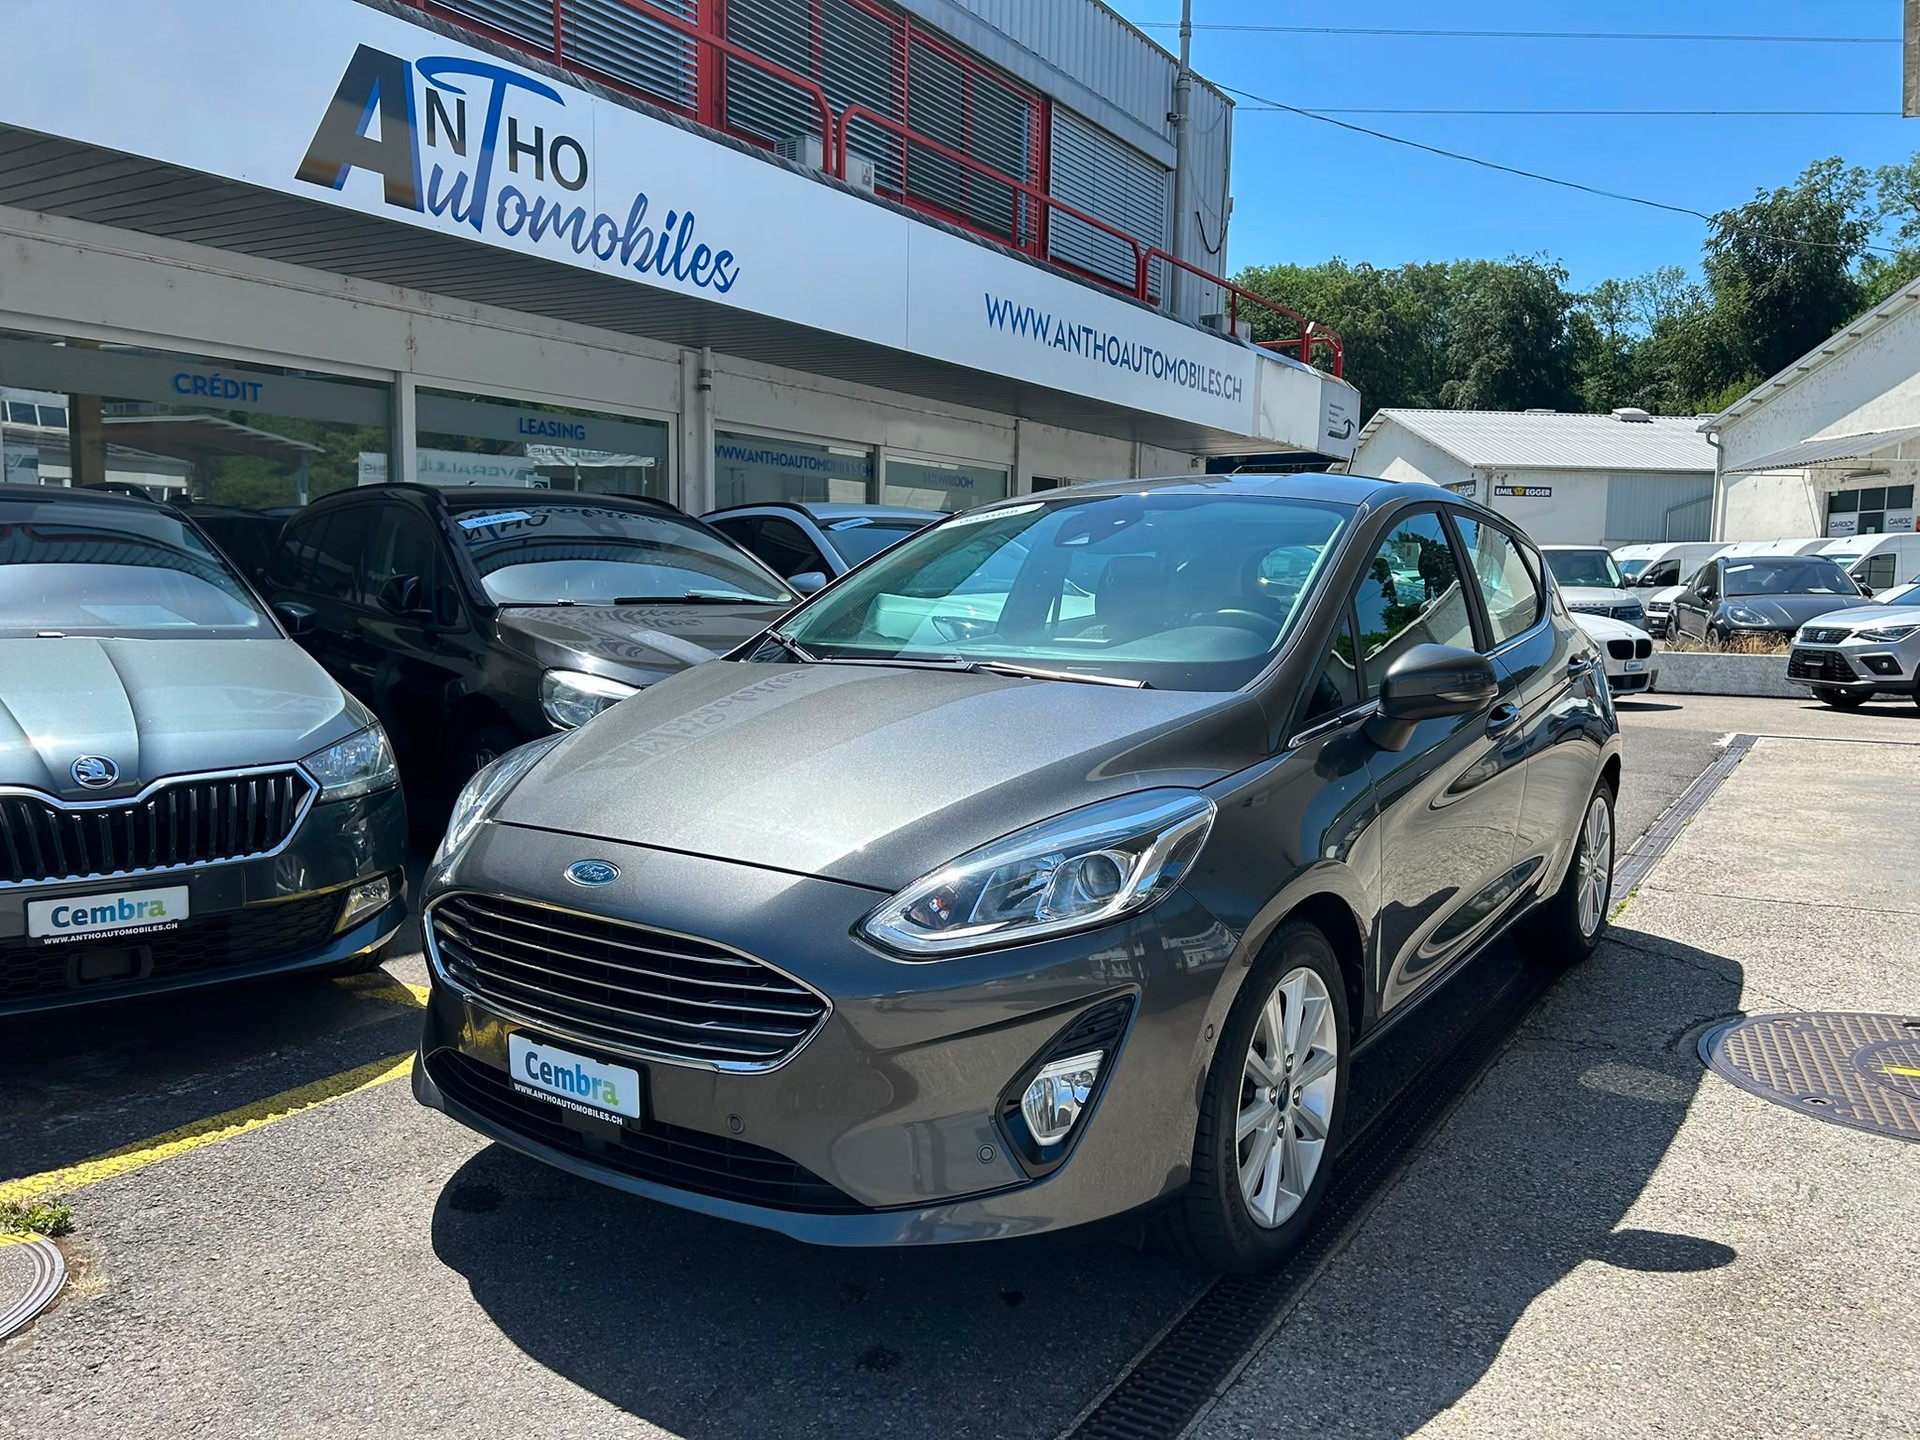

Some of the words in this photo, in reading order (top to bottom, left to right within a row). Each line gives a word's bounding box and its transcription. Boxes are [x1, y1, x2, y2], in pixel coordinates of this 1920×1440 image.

[294, 43, 588, 232] ANTHO
[984, 293, 1242, 402] WWW.ANTHOAUTOMOBILES.CH
[174, 373, 263, 401] CRÉDIT
[519, 417, 586, 441] LEASING
[1496, 487, 1513, 495] EMIL
[1525, 488, 1550, 496] EGGER
[51, 898, 166, 928] Cembra
[44, 922, 179, 945] WWW.ANTHOAUTOMOBILES.CH
[525, 1051, 619, 1105] Cembra
[514, 1082, 623, 1125] WWW.ANTHOAUTOMOBILES.CH
